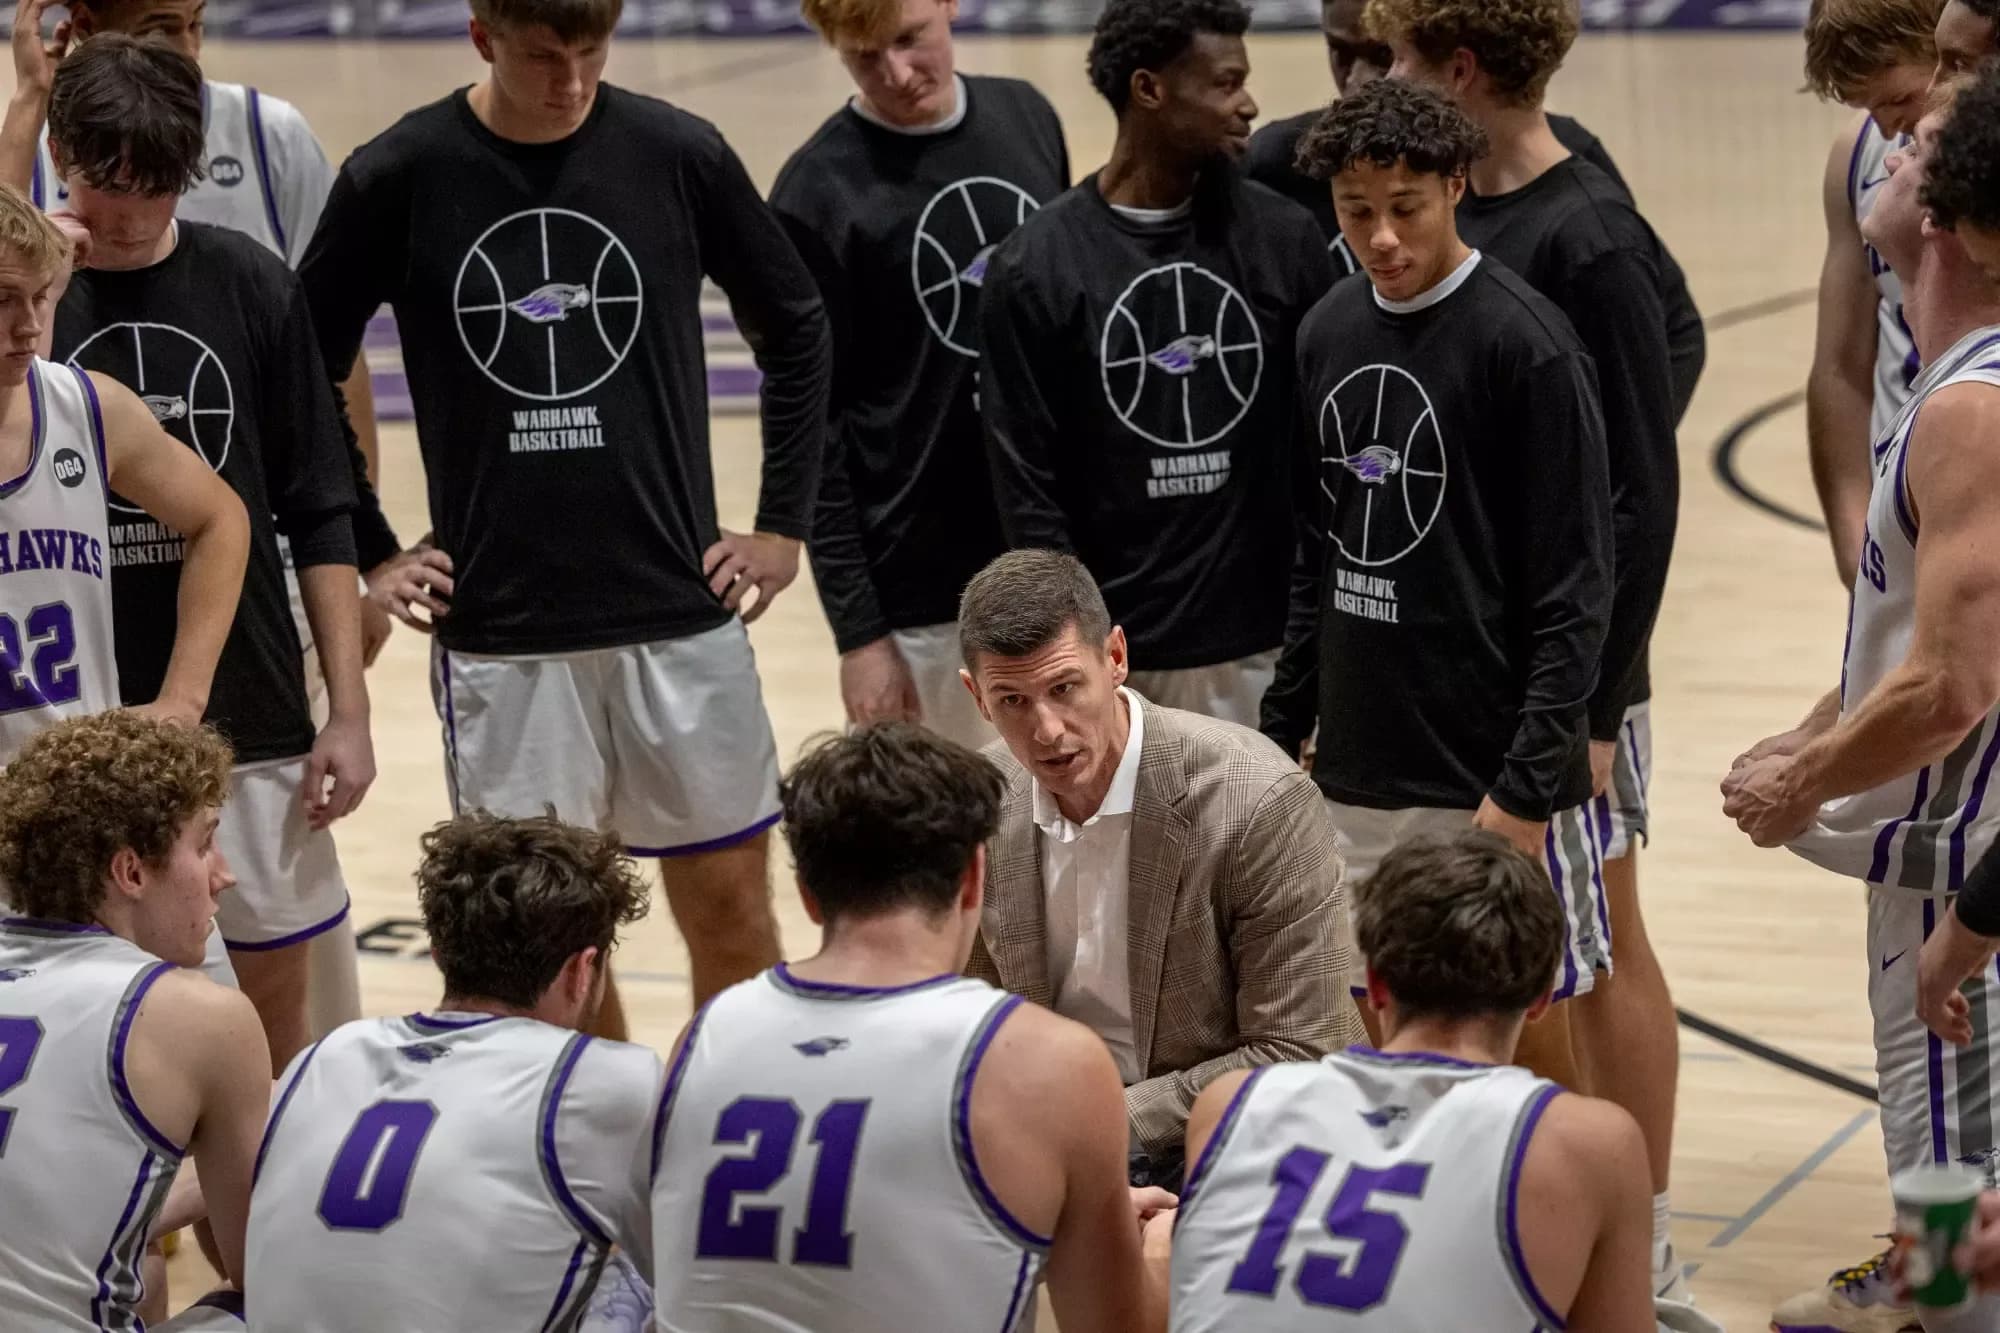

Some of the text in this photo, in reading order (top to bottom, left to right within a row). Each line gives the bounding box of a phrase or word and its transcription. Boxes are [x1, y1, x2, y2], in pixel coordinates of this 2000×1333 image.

[509, 427, 606, 453] BASKETBALL
[513, 405, 602, 430] WARHAWK
[55, 456, 84, 480] DG4
[314, 1097, 441, 1235] 0
[694, 1093, 874, 1270] 21
[1223, 1143, 1435, 1316] 15
